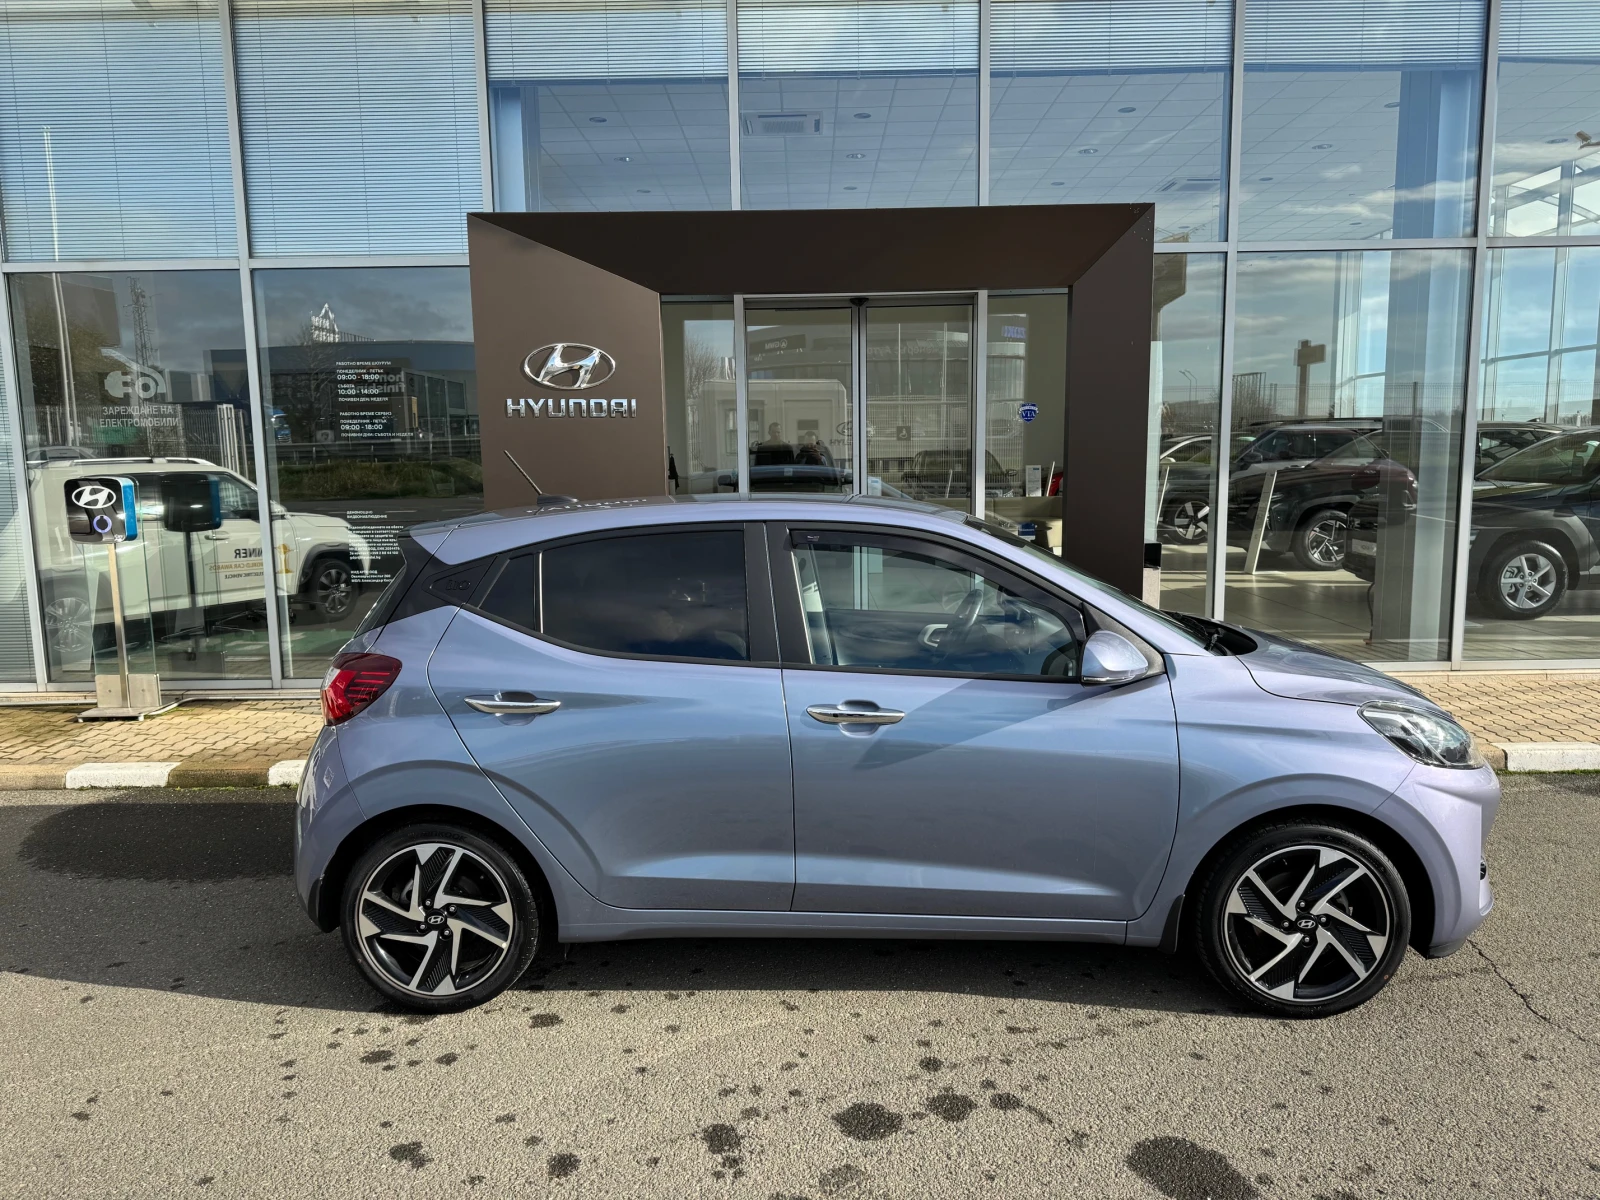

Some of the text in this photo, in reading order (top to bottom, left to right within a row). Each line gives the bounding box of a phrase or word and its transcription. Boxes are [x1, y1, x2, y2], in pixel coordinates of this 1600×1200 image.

[102, 406, 174, 416] ЗАРЕЖДАНЕ НА
[506, 398, 637, 417] HYUNDAI
[100, 418, 179, 428] ЕЛЕКТРОМОБИЛИ
